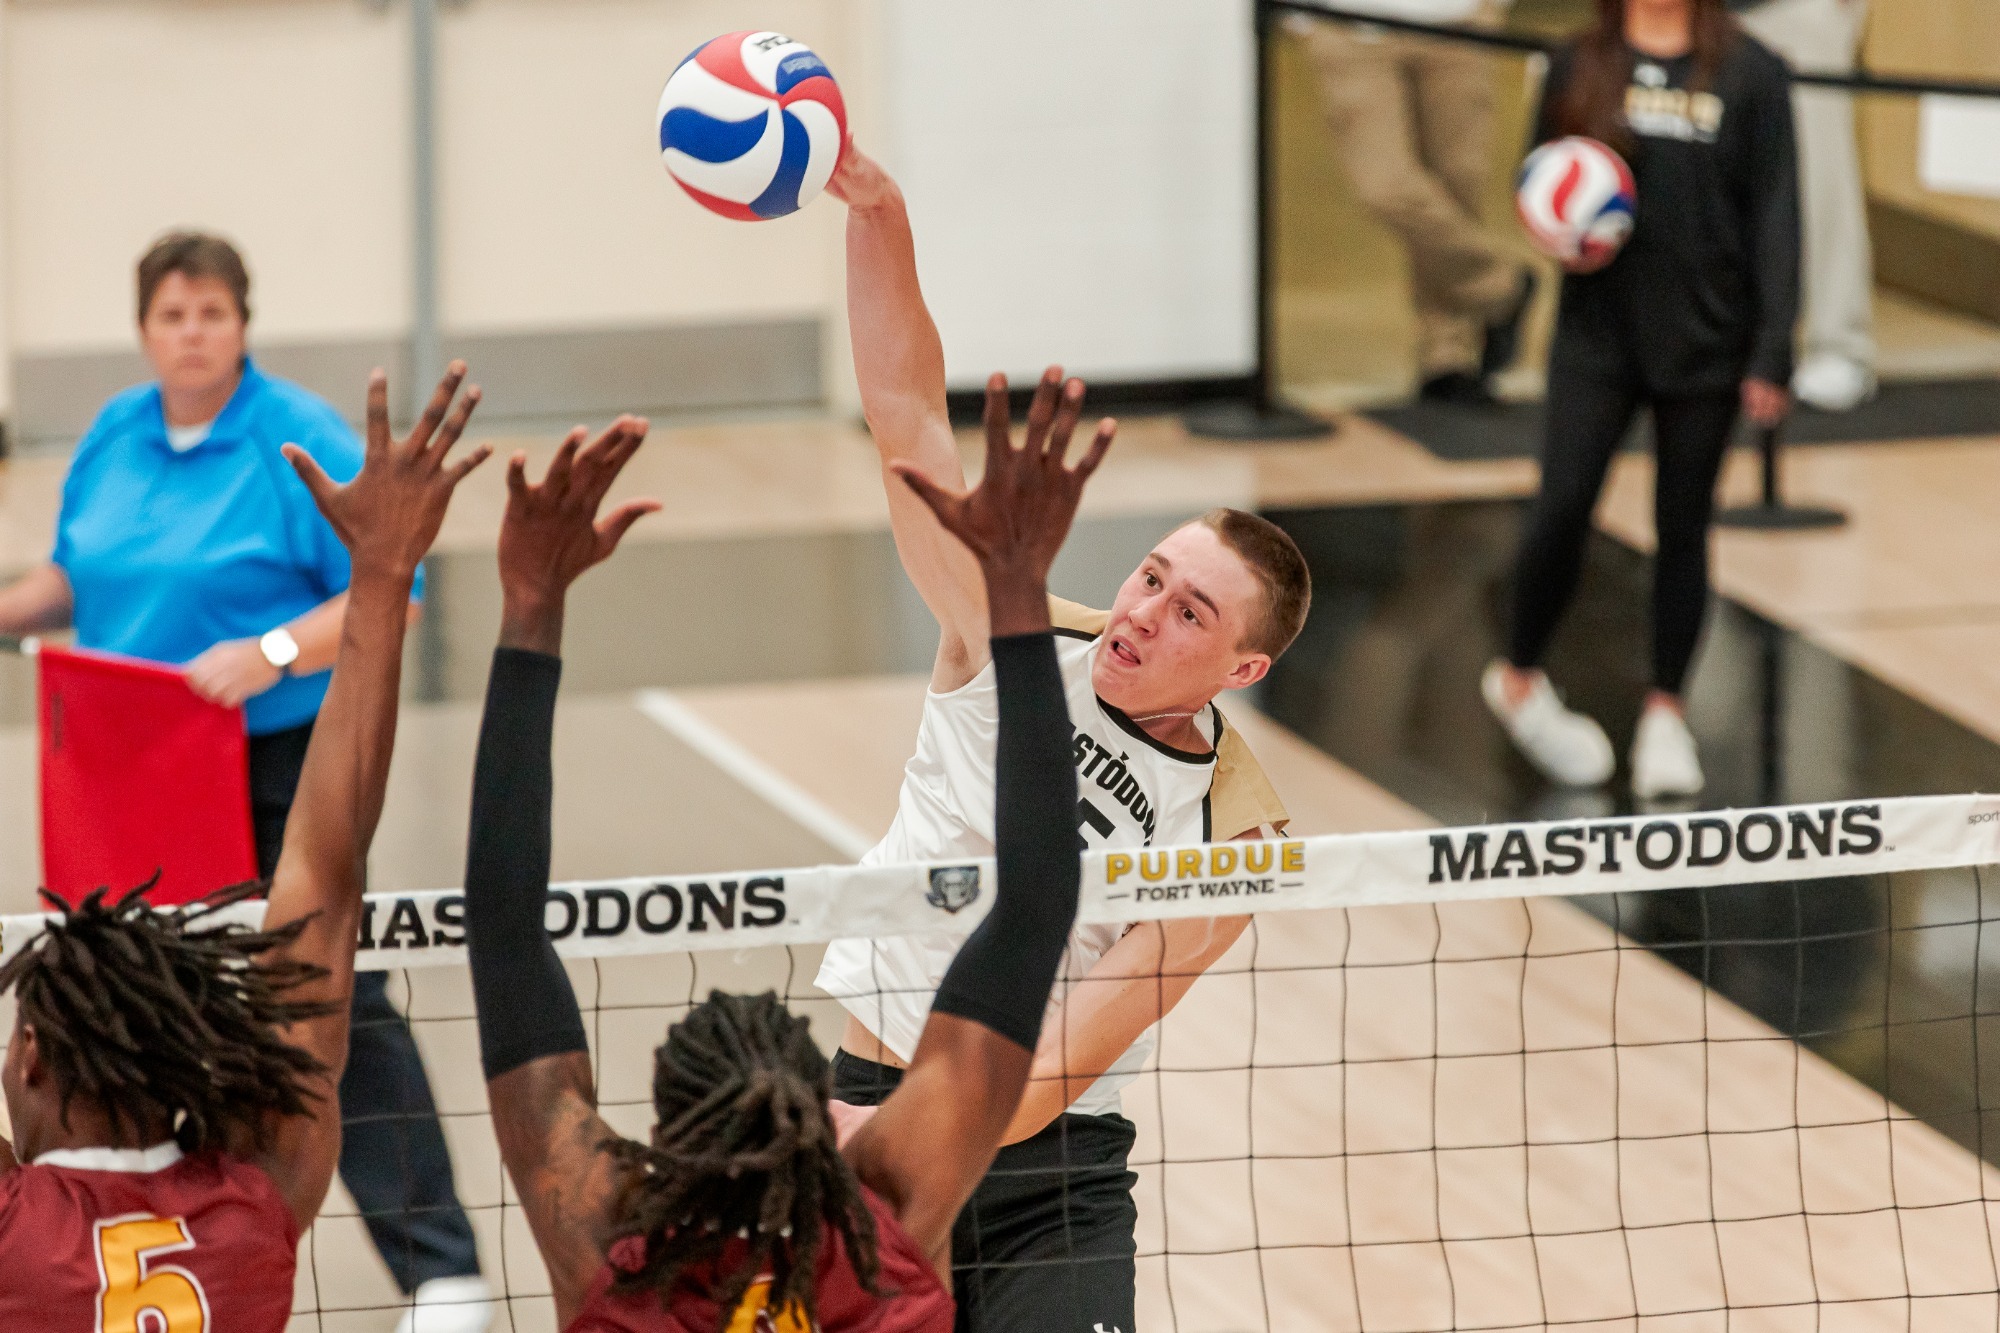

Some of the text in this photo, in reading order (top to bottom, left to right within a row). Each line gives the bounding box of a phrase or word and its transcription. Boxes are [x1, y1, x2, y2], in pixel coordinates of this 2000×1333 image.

[1106, 842, 1306, 885] PURDUE
[1429, 804, 1884, 884] MASTODONS
[1136, 879, 1276, 903] FORT WAYNE
